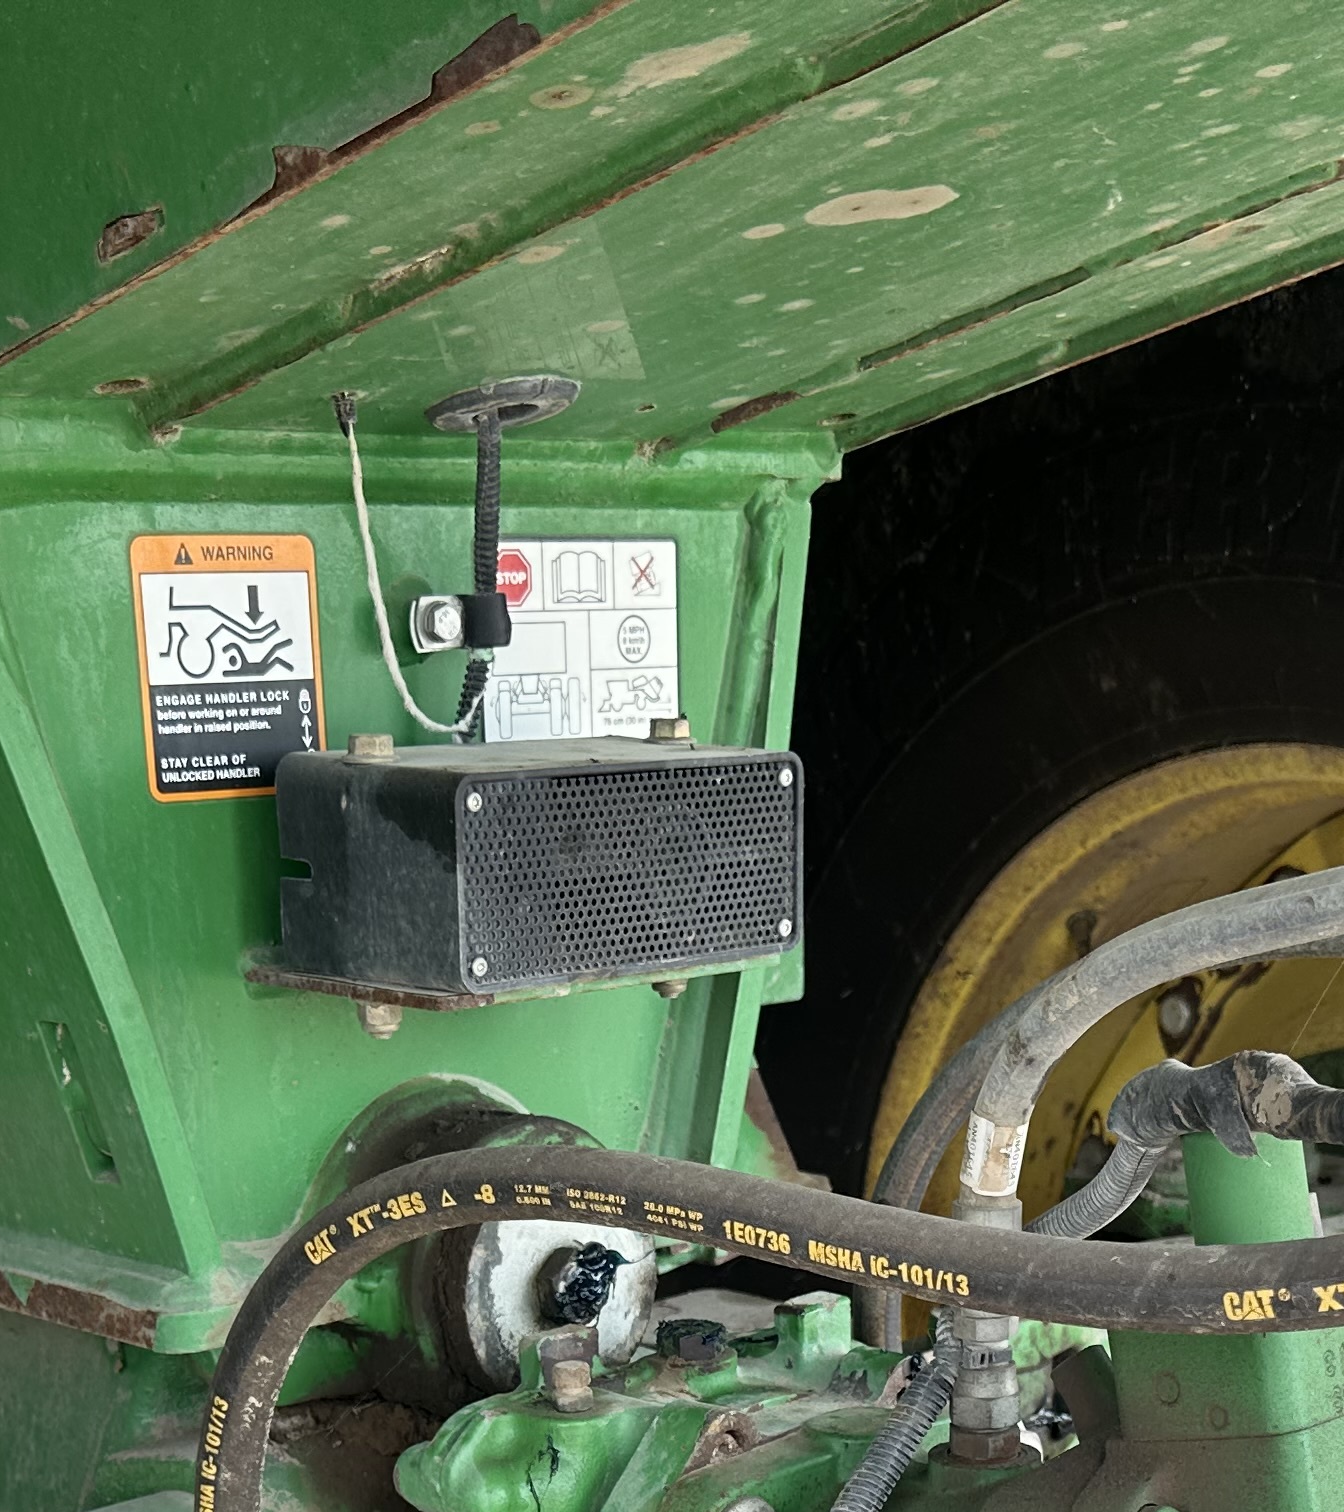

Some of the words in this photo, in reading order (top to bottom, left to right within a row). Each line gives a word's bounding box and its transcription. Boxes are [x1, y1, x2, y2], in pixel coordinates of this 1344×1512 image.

[200, 545, 274, 562] WARNING
[495, 571, 527, 585] STOP
[156, 694, 202, 706] ENGAGE
[205, 692, 257, 705] HANDLER
[260, 690, 290, 702] LOCK
[157, 709, 187, 721] before
[188, 707, 224, 721] working
[158, 722, 192, 734] handler
[193, 722, 203, 733] in
[161, 757, 188, 769] STAY
[191, 755, 229, 767] CLEAR
[231, 753, 247, 765] OF
[162, 771, 215, 783] UNLOCKED
[216, 767, 261, 780] HANDLER
[514, 1184, 533, 1194] 12.7
[566, 1188, 581, 1199] ISO
[687, 1209, 704, 1221] WP
[689, 1221, 705, 1233] WP
[722, 1219, 792, 1255] 1E0736
[808, 1239, 866, 1274] MSHA
[869, 1254, 970, 1297] IC-101/13
[201, 1395, 229, 1481] IC-101/13
